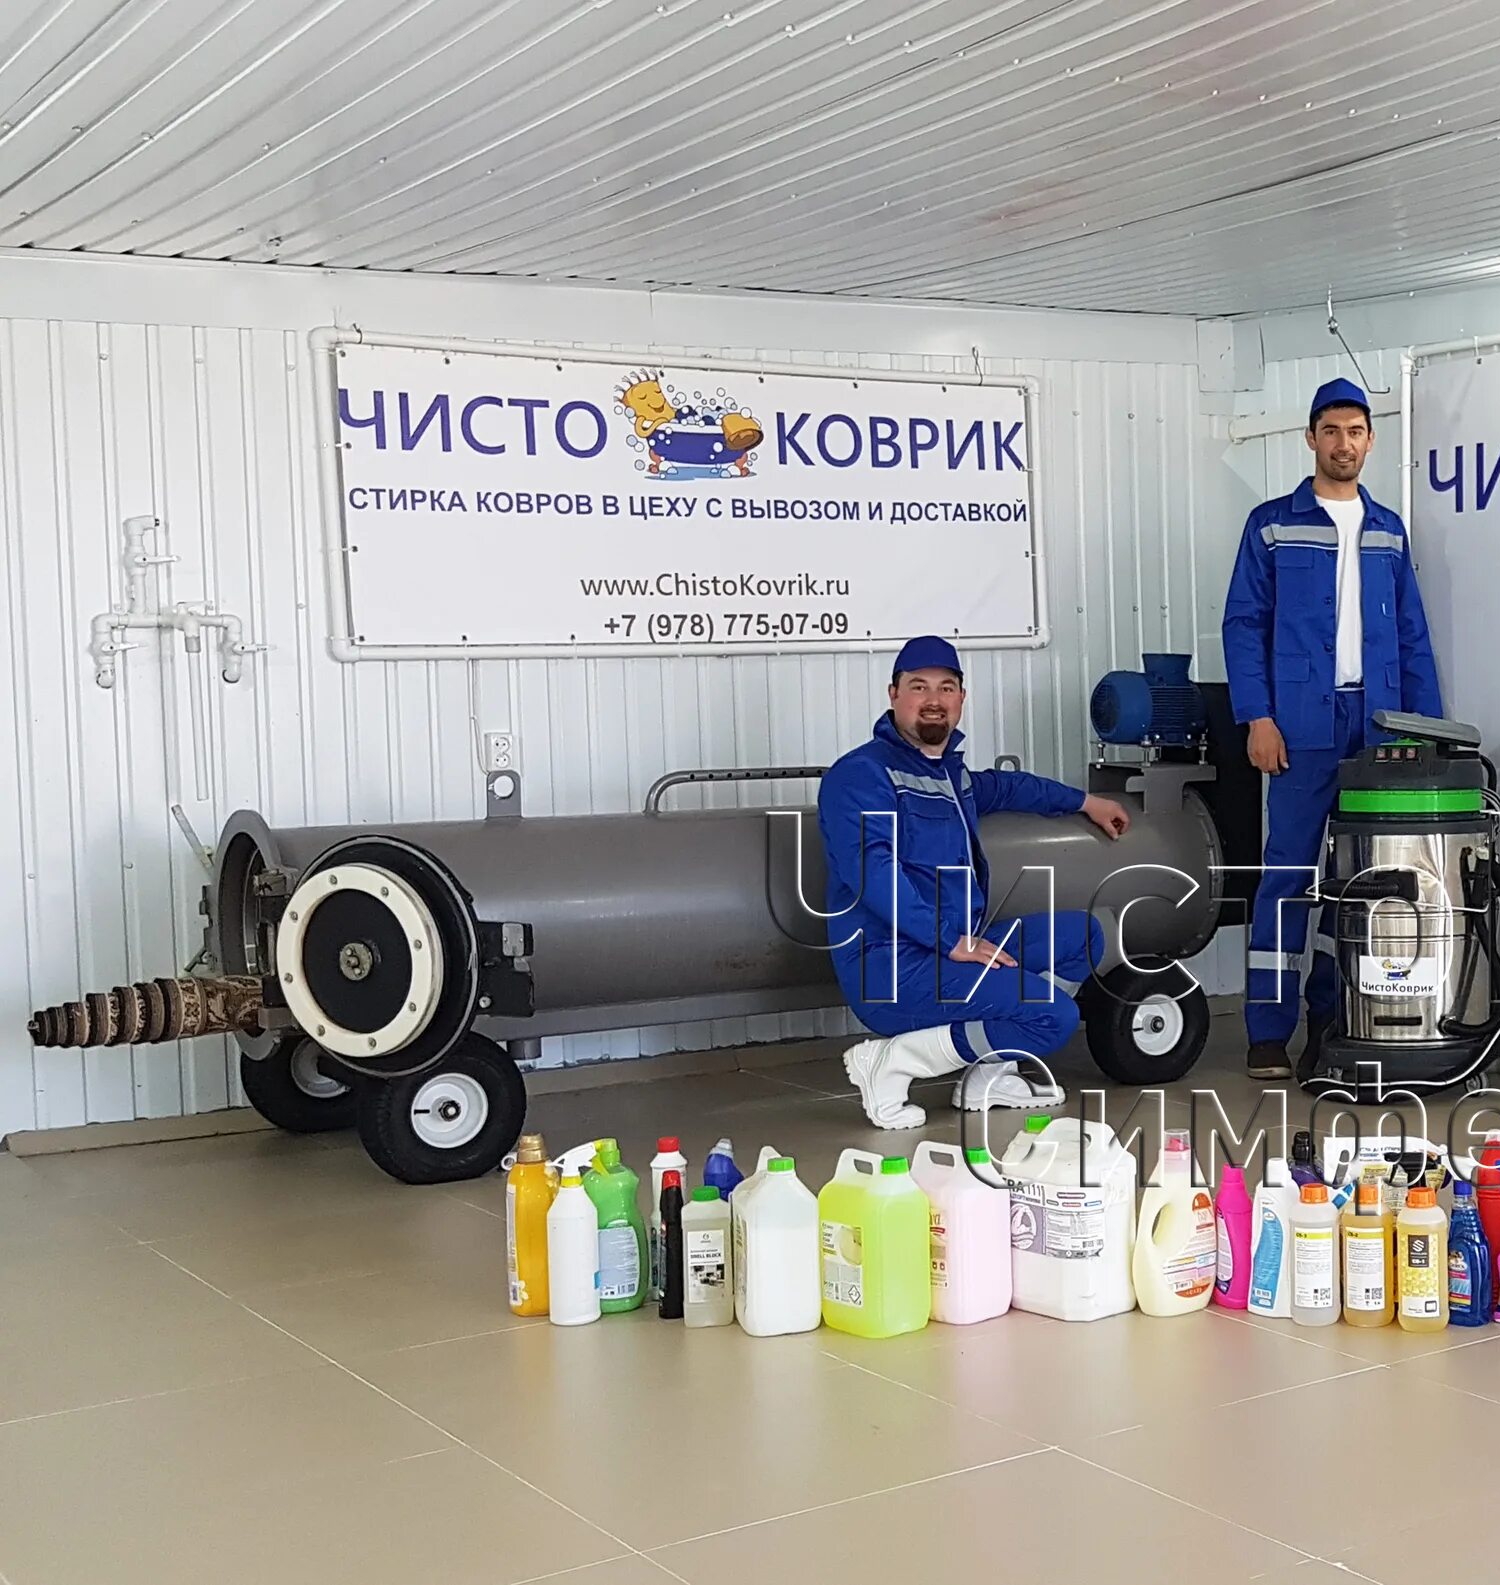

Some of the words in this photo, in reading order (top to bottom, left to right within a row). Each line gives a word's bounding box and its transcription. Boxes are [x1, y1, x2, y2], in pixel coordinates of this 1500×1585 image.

[338, 388, 608, 456] ЧИСТО
[776, 411, 1025, 471] КОВРИК
[348, 487, 468, 513] СТИРКА
[476, 491, 594, 515] КОВРОВ
[602, 494, 621, 516] В
[629, 495, 698, 521] ЦЕХУ
[705, 497, 723, 518] С
[731, 498, 861, 522] ВЫВОЗОМ
[868, 501, 884, 521] И
[890, 498, 1028, 525] ДОСТАВКОЙ
[580, 572, 850, 598] www.ChistoKovrik.ru
[604, 614, 637, 637] +7
[647, 613, 714, 643] (978)
[723, 612, 850, 637] 775-07-09
[1361, 981, 1434, 995] ЧистоКоврик
